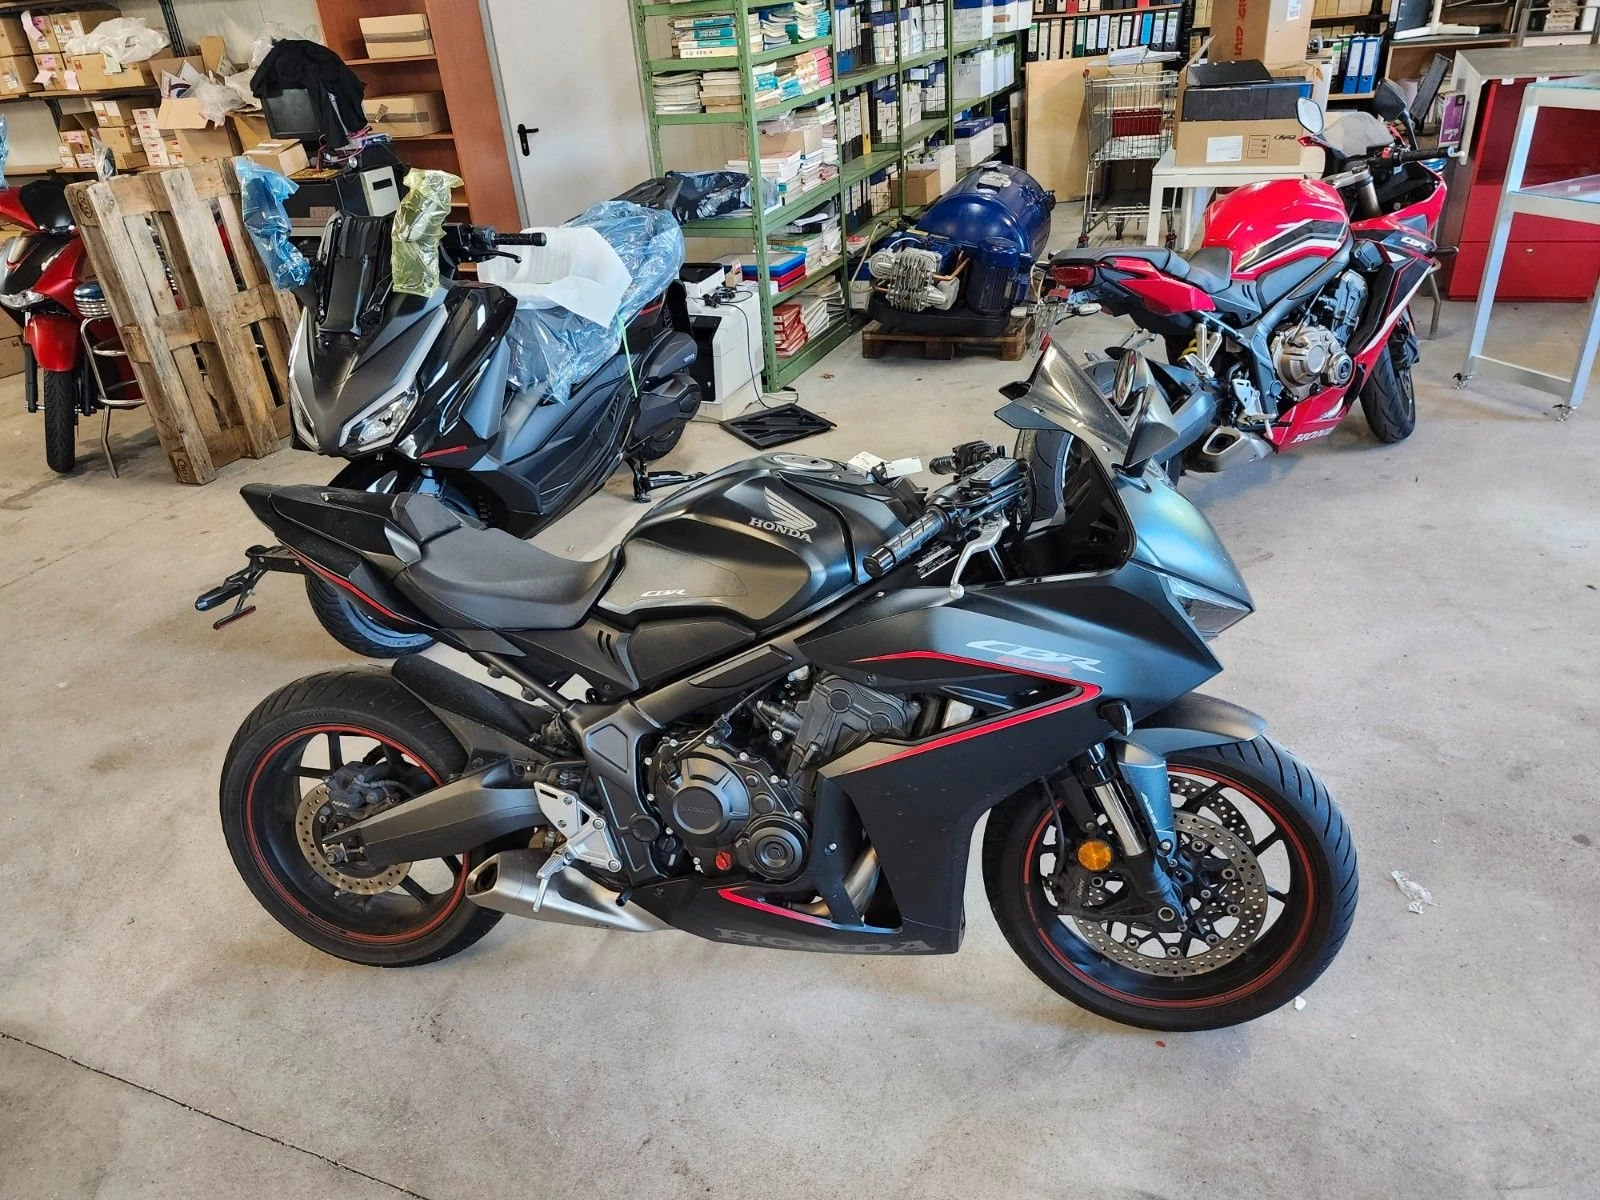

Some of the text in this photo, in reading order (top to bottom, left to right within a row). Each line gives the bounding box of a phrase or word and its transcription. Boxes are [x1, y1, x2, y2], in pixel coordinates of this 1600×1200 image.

[1234, 25, 1243, 56] GIVI
[748, 516, 814, 544] HONDA
[965, 640, 1106, 675] CBR
[714, 927, 938, 951] HONDA
